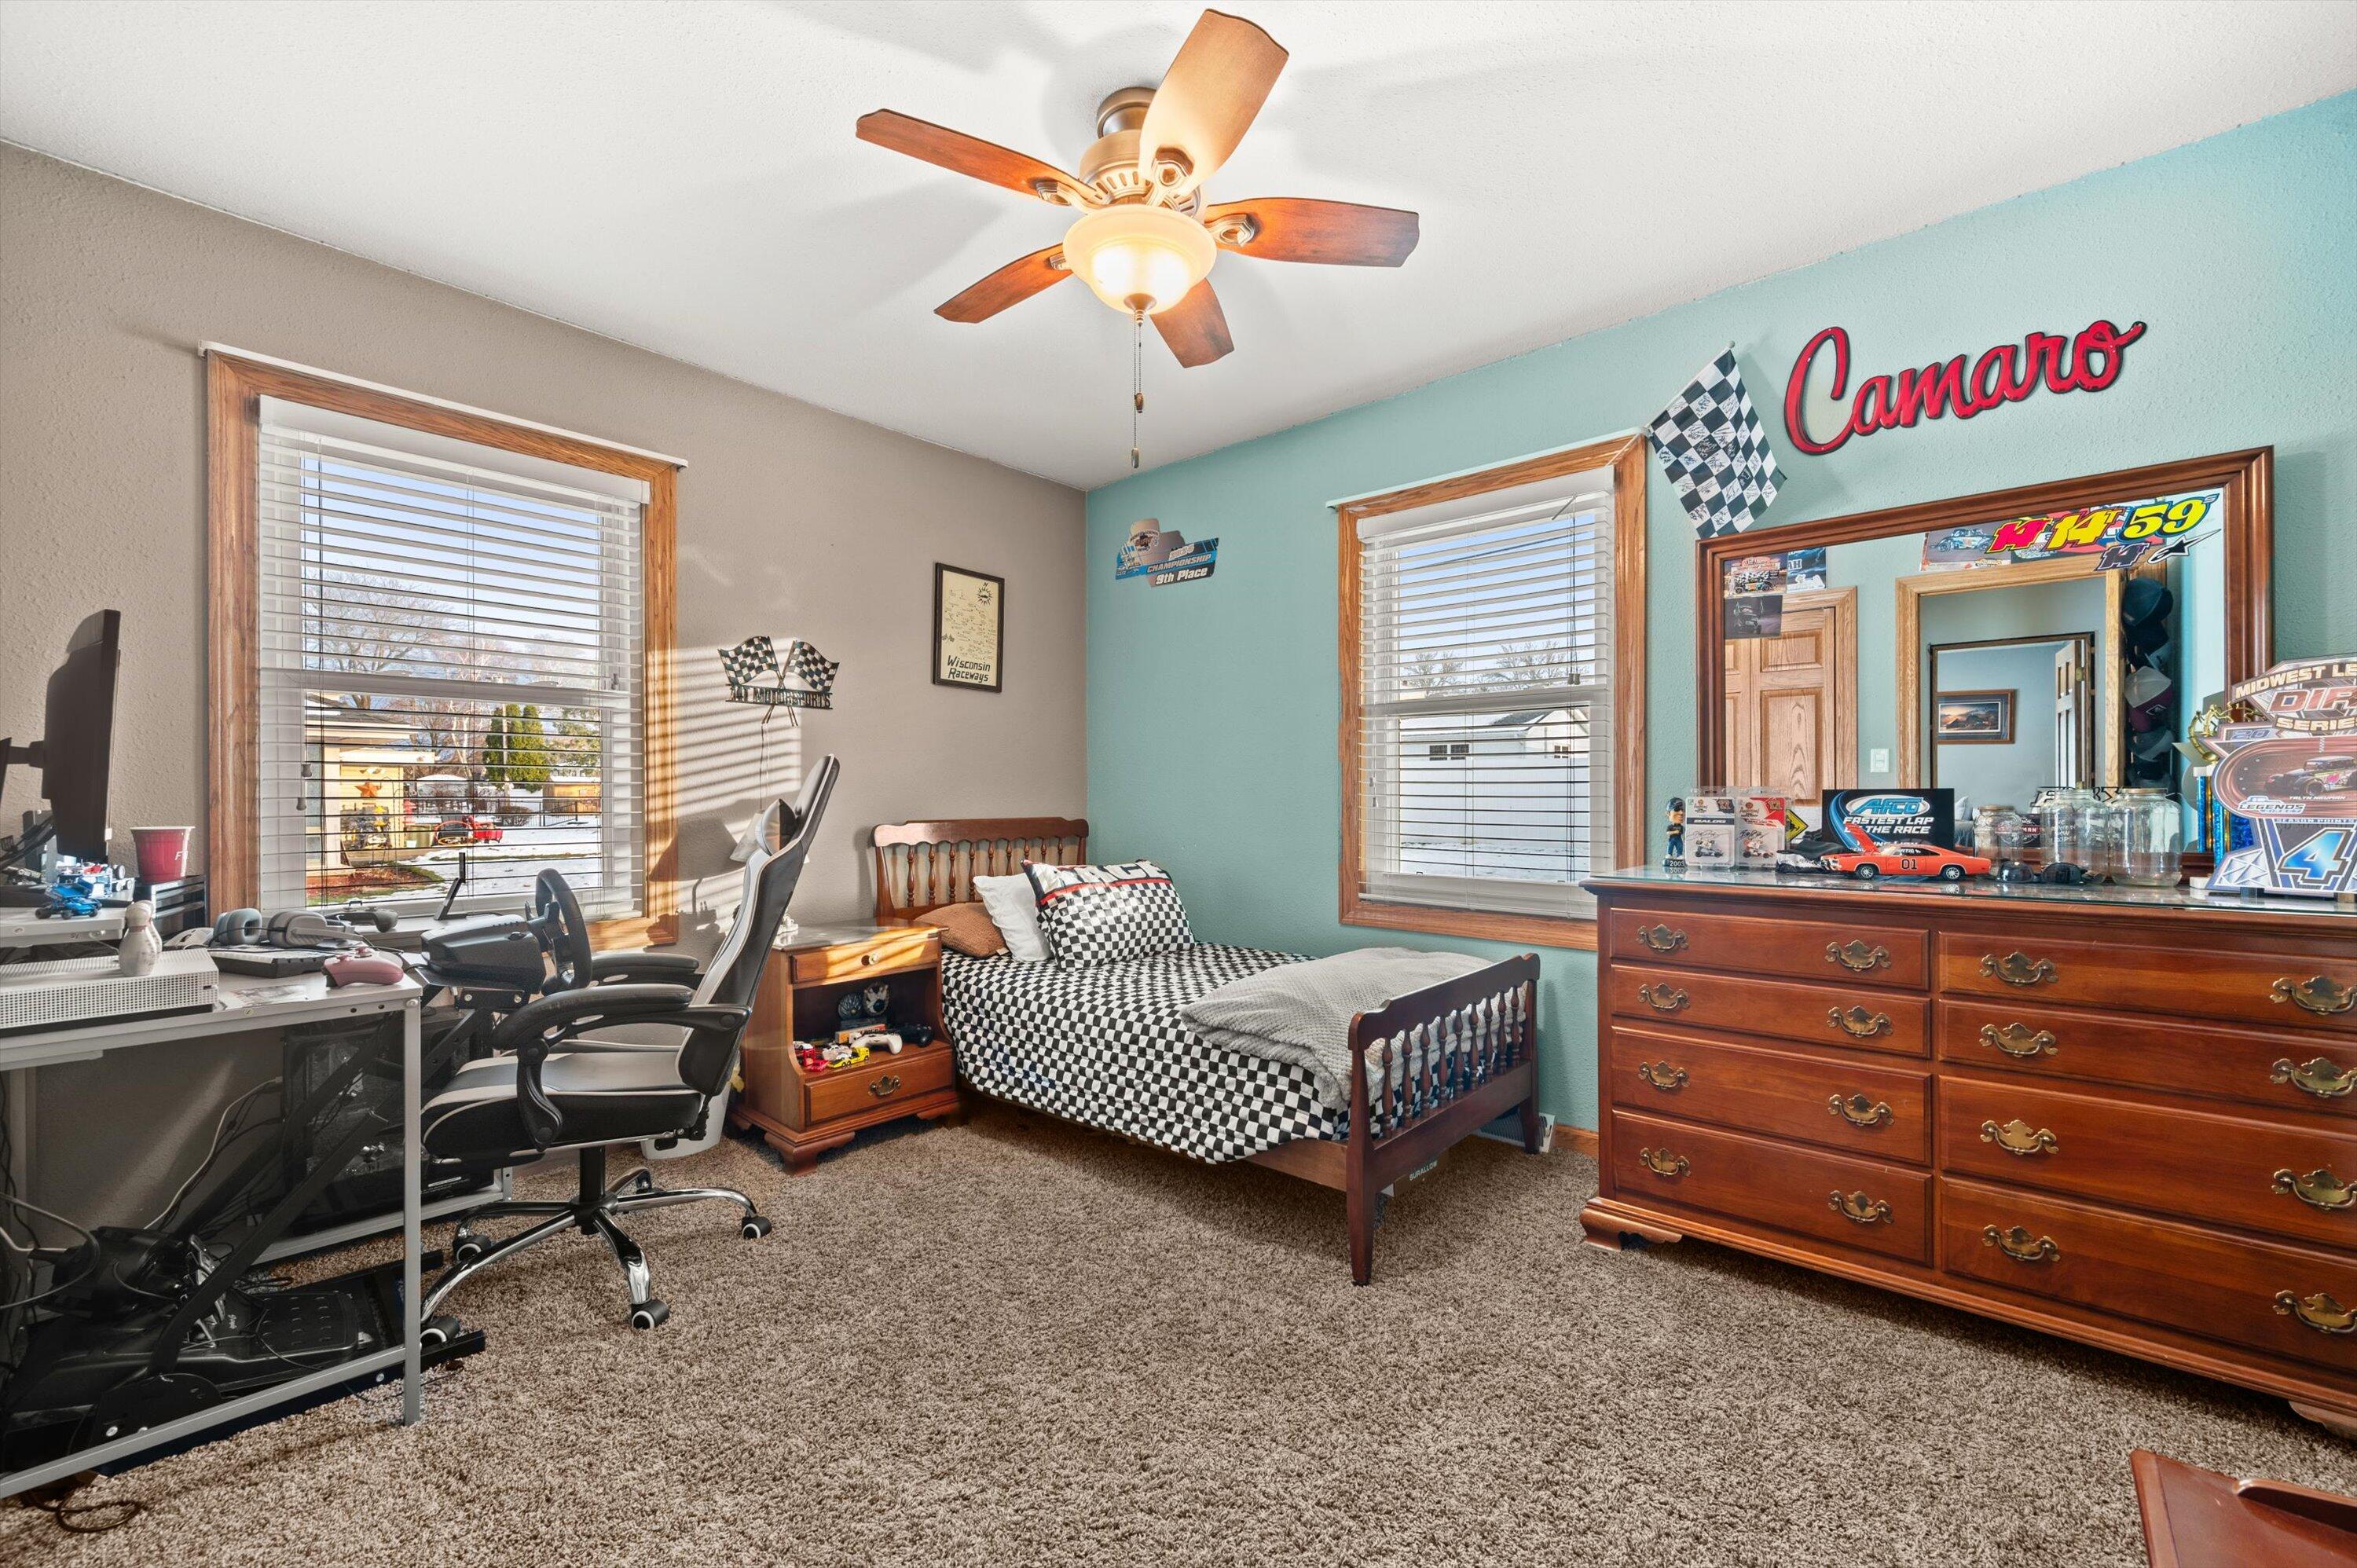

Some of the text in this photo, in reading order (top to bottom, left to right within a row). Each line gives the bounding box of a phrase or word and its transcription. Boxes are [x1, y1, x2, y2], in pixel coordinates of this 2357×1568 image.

[1784, 320, 2146, 455] Camaro
[1147, 554, 1211, 573] CHAMPIONSHIP
[1156, 566, 1208, 584] 9th Place
[947, 654, 991, 672] Wisconsin
[948, 668, 988, 683] Raceways
[2235, 665, 2326, 699] MIDWEST
[2276, 716, 2357, 731] SERIE
[1843, 816, 1934, 825] FASTEST LAP
[1867, 825, 1890, 833] THE
[1893, 825, 1931, 833] RACE
[2279, 827, 2350, 882] 4
[1901, 858, 1918, 870] 01
